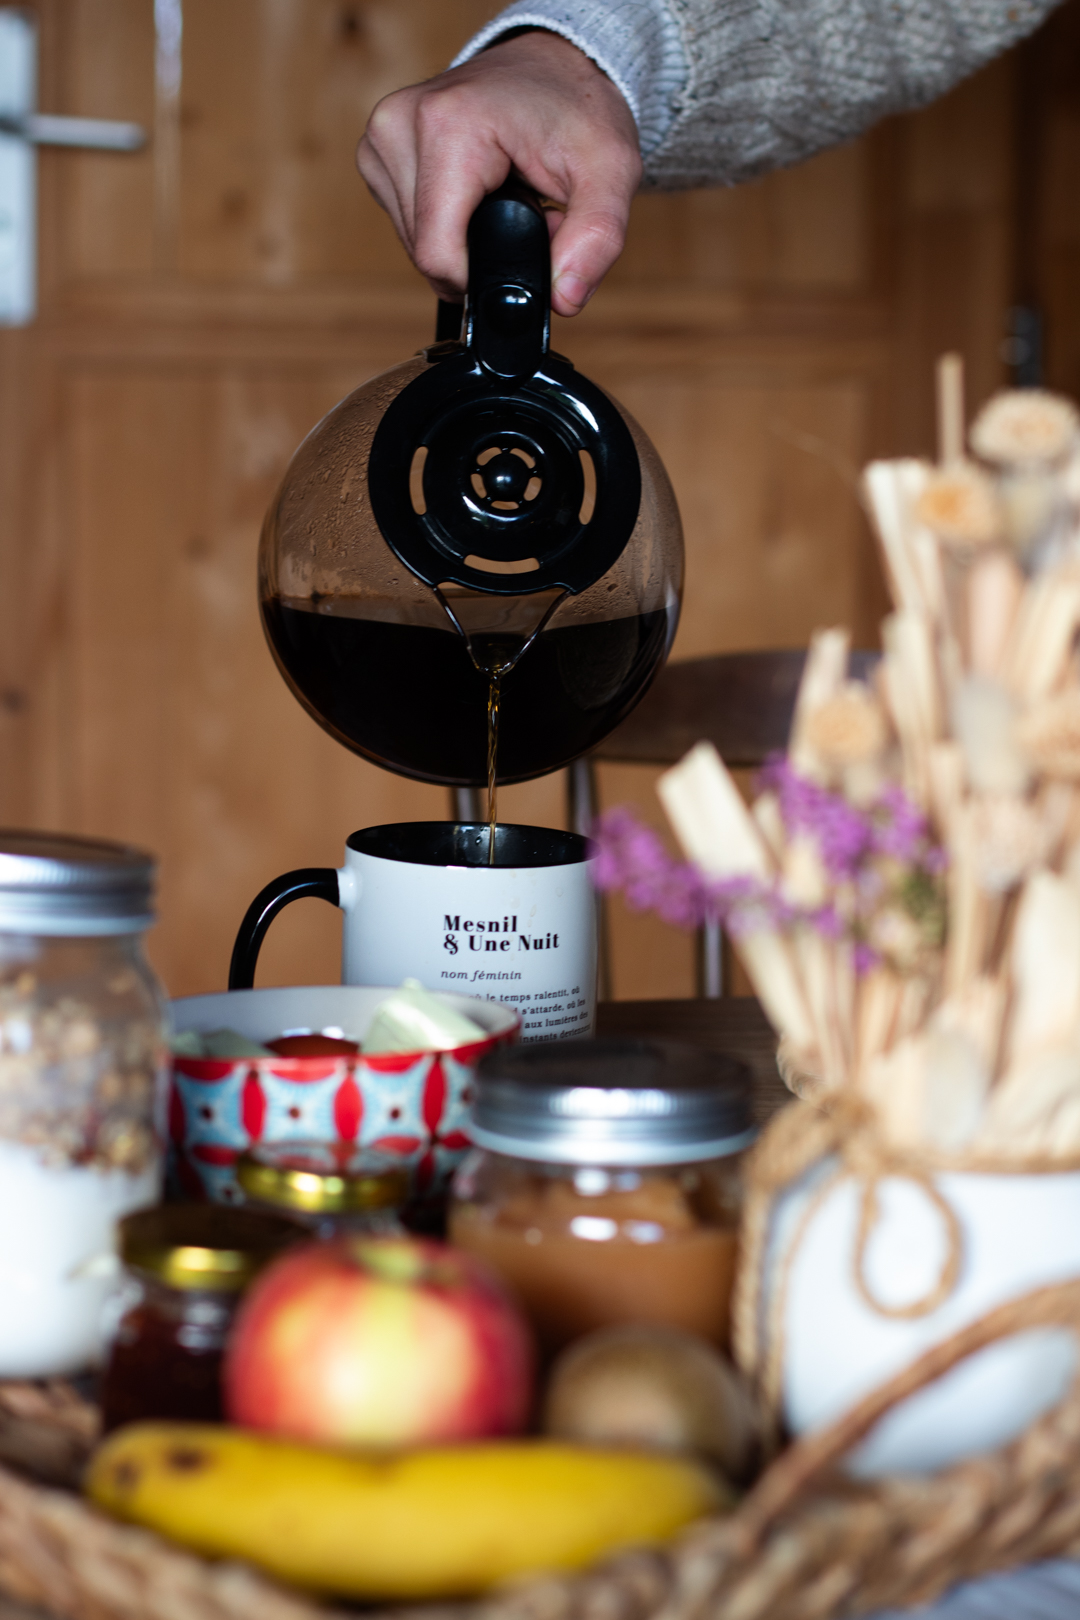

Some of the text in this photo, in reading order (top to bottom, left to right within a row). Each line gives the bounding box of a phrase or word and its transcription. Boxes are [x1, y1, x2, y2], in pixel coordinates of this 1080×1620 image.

[443, 914, 518, 933] Mesnil
[443, 932, 560, 955] & Une Nuit
[440, 969, 522, 982] nom féminin
[486, 993, 496, 1002] le
[500, 994, 531, 1003] temps
[577, 998, 586, 1008] les
[524, 1011, 589, 1029] aux lumières des
